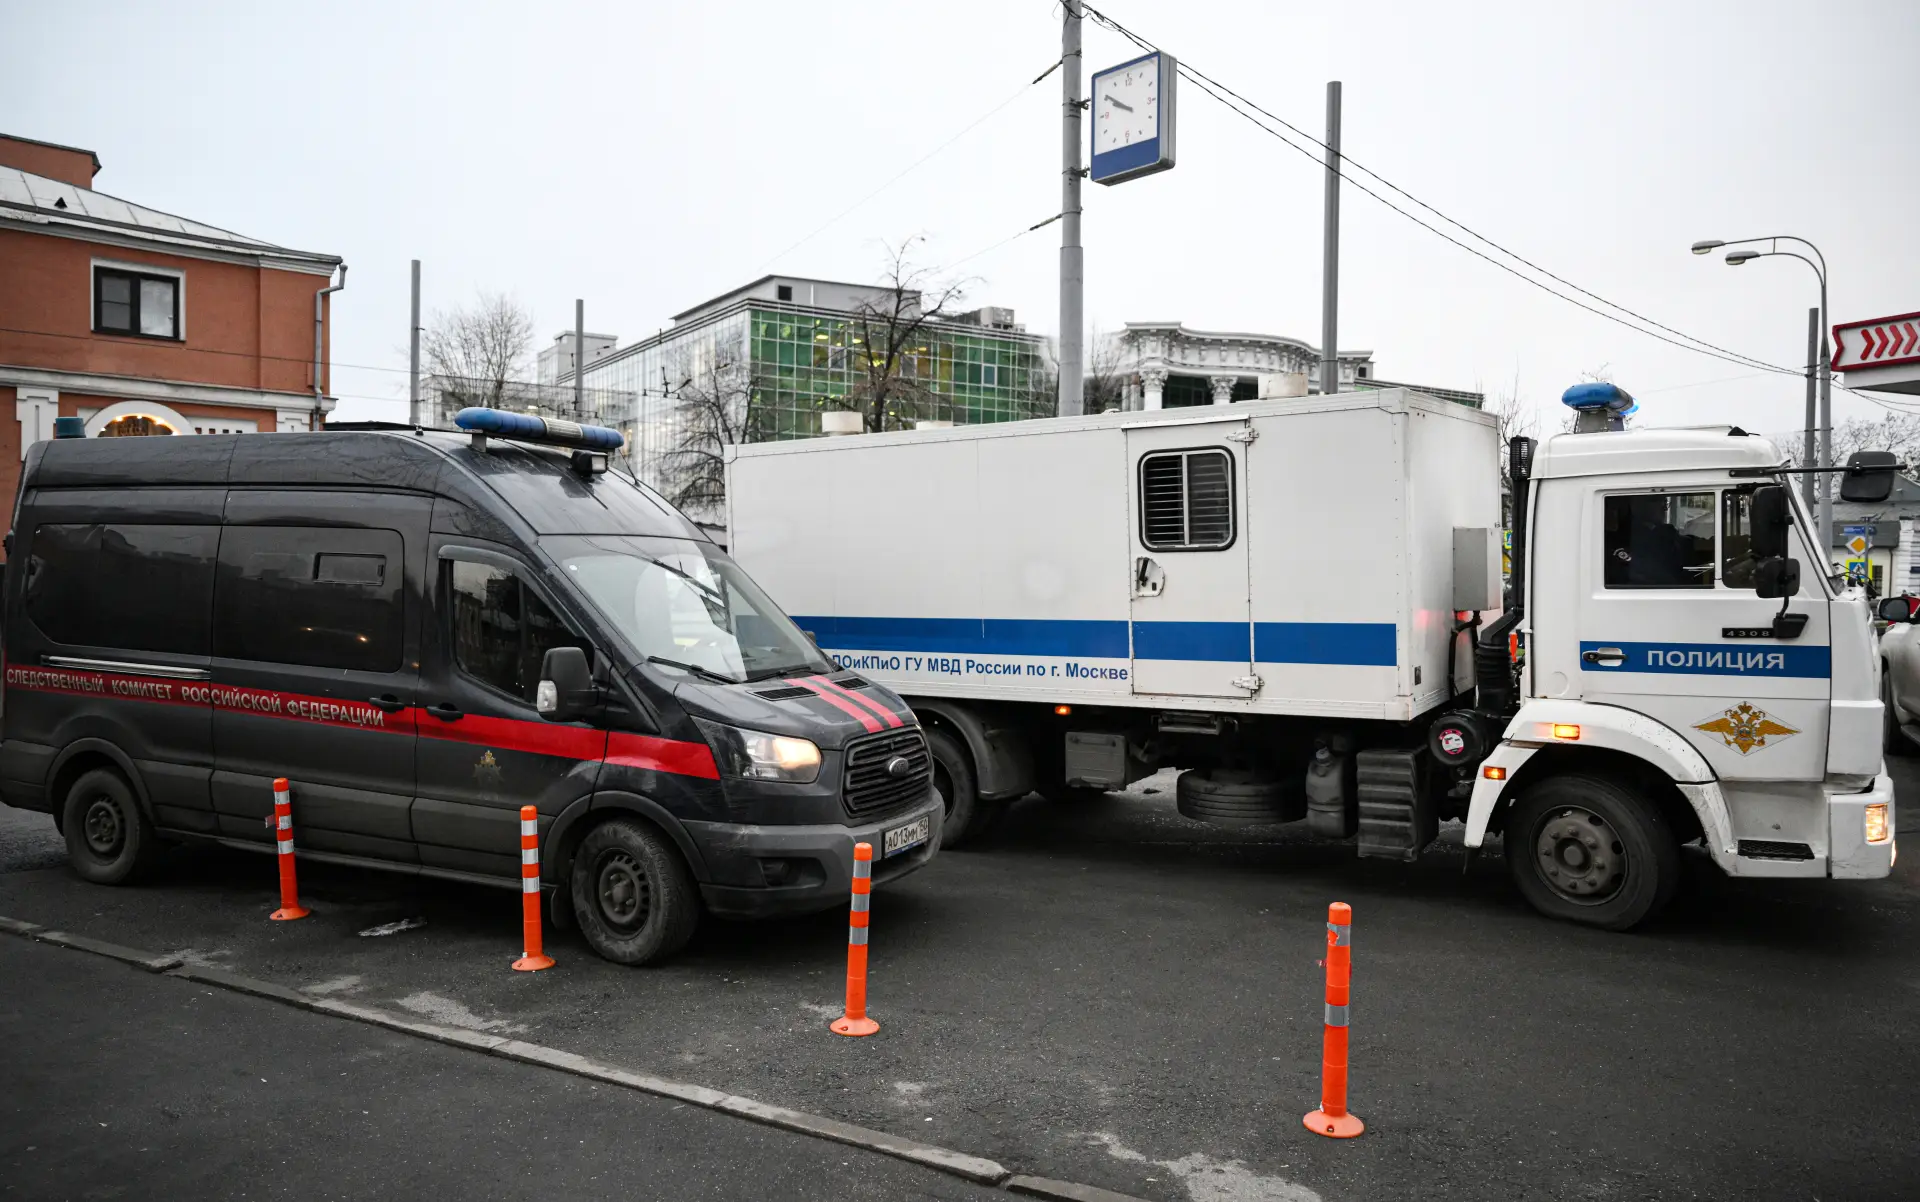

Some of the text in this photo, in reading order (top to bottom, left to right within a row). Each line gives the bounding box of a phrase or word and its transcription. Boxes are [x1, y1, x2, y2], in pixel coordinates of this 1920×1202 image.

[1125, 78, 1132, 87] 12
[1147, 97, 1152, 105] 3
[1104, 111, 1110, 120] 9
[1125, 130, 1130, 138] 6
[1647, 650, 1785, 671] ПОЛИЦИЯ
[905, 657, 922, 671] ГУ
[927, 658, 962, 676] МВД
[966, 660, 1021, 676] России
[1027, 664, 1046, 677] по
[1052, 666, 1061, 677] г.
[1066, 663, 1128, 680] Москве
[6, 668, 385, 727] СЛЕДСТВЕННЫЙ КОМИТЕТ РОССИЙСКОЙ ФЕДЕРАЦИИ
